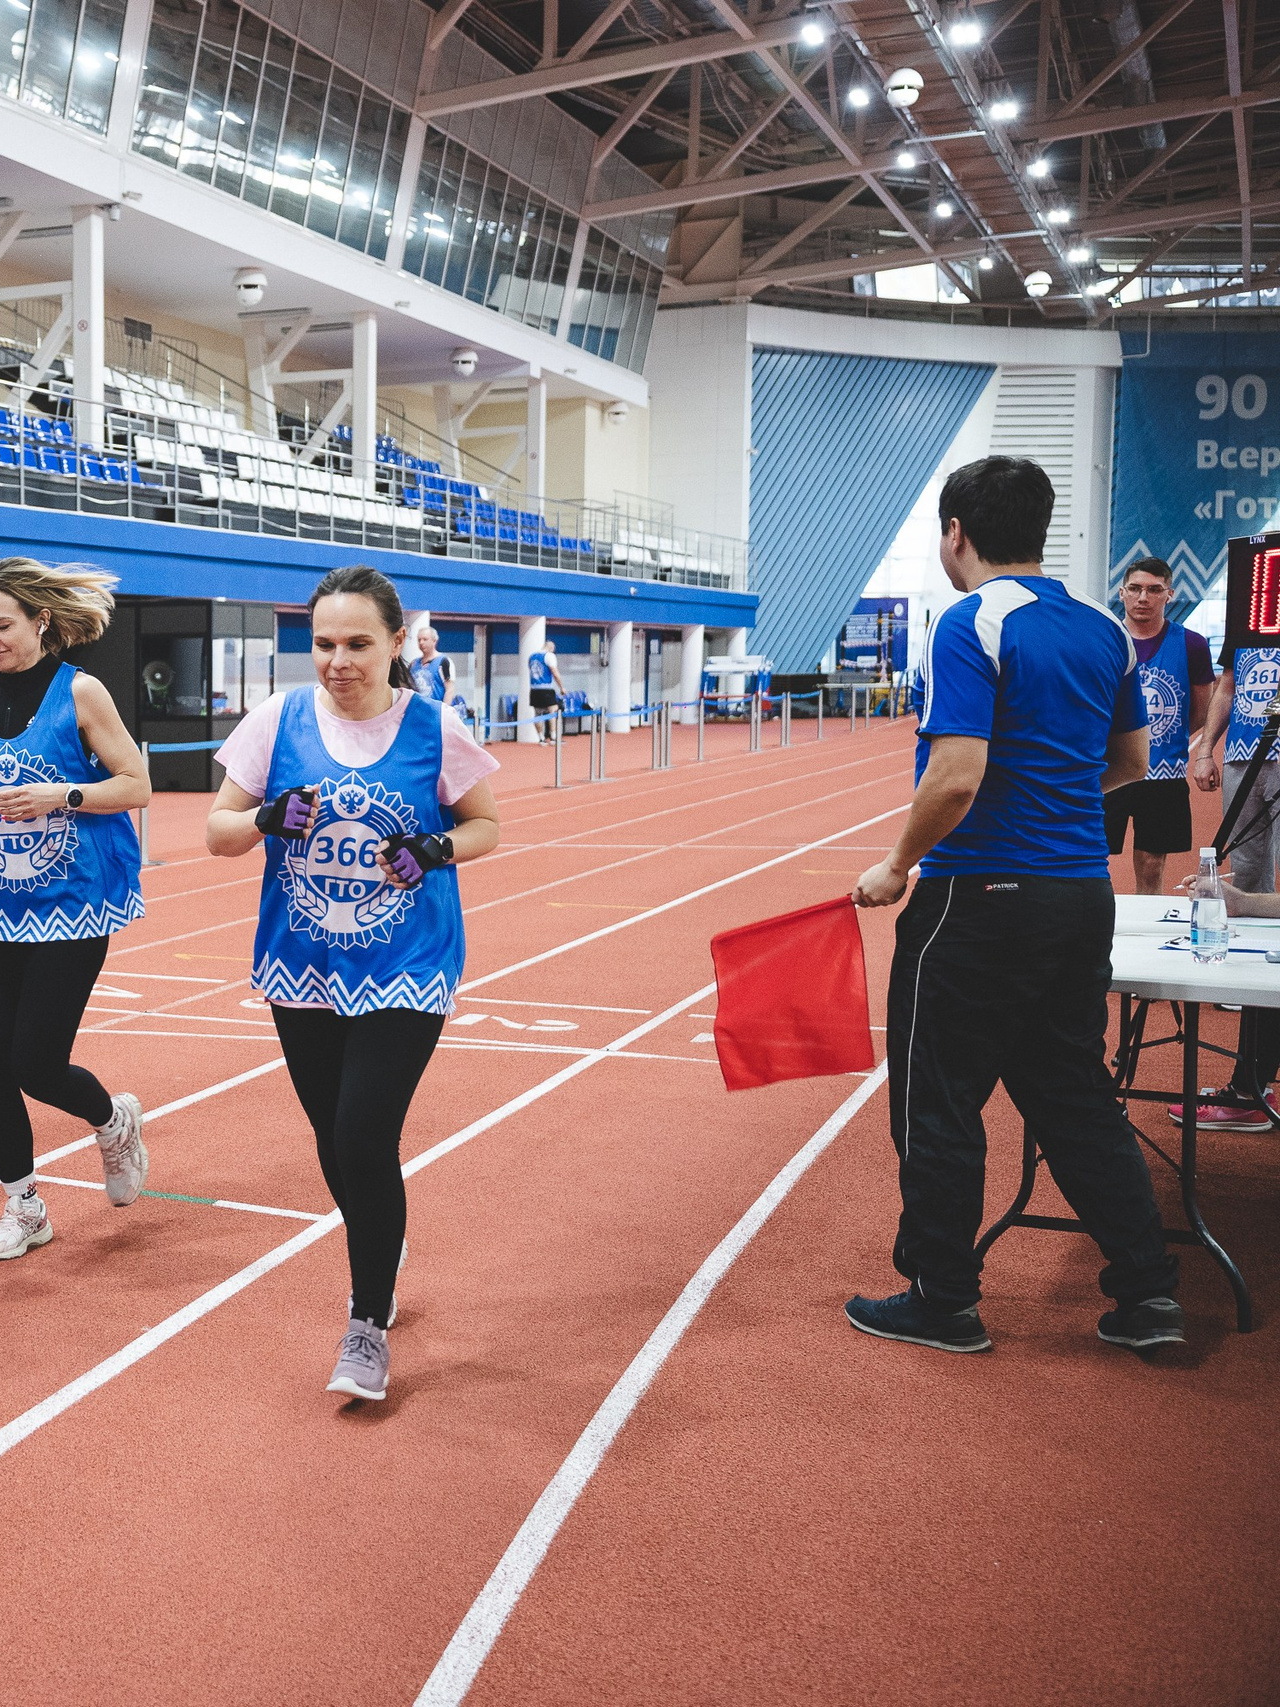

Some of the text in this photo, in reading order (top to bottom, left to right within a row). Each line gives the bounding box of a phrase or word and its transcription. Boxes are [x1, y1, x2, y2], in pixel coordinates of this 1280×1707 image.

[1195, 374, 1268, 420] 90
[1196, 439, 1280, 478] Всер
[1249, 535, 1267, 545] LYNX
[1248, 668, 1279, 685] 361
[1250, 689, 1273, 701] ГТО
[0, 834, 34, 850] ГТО
[314, 836, 379, 868] 366
[324, 878, 366, 899] ГТО
